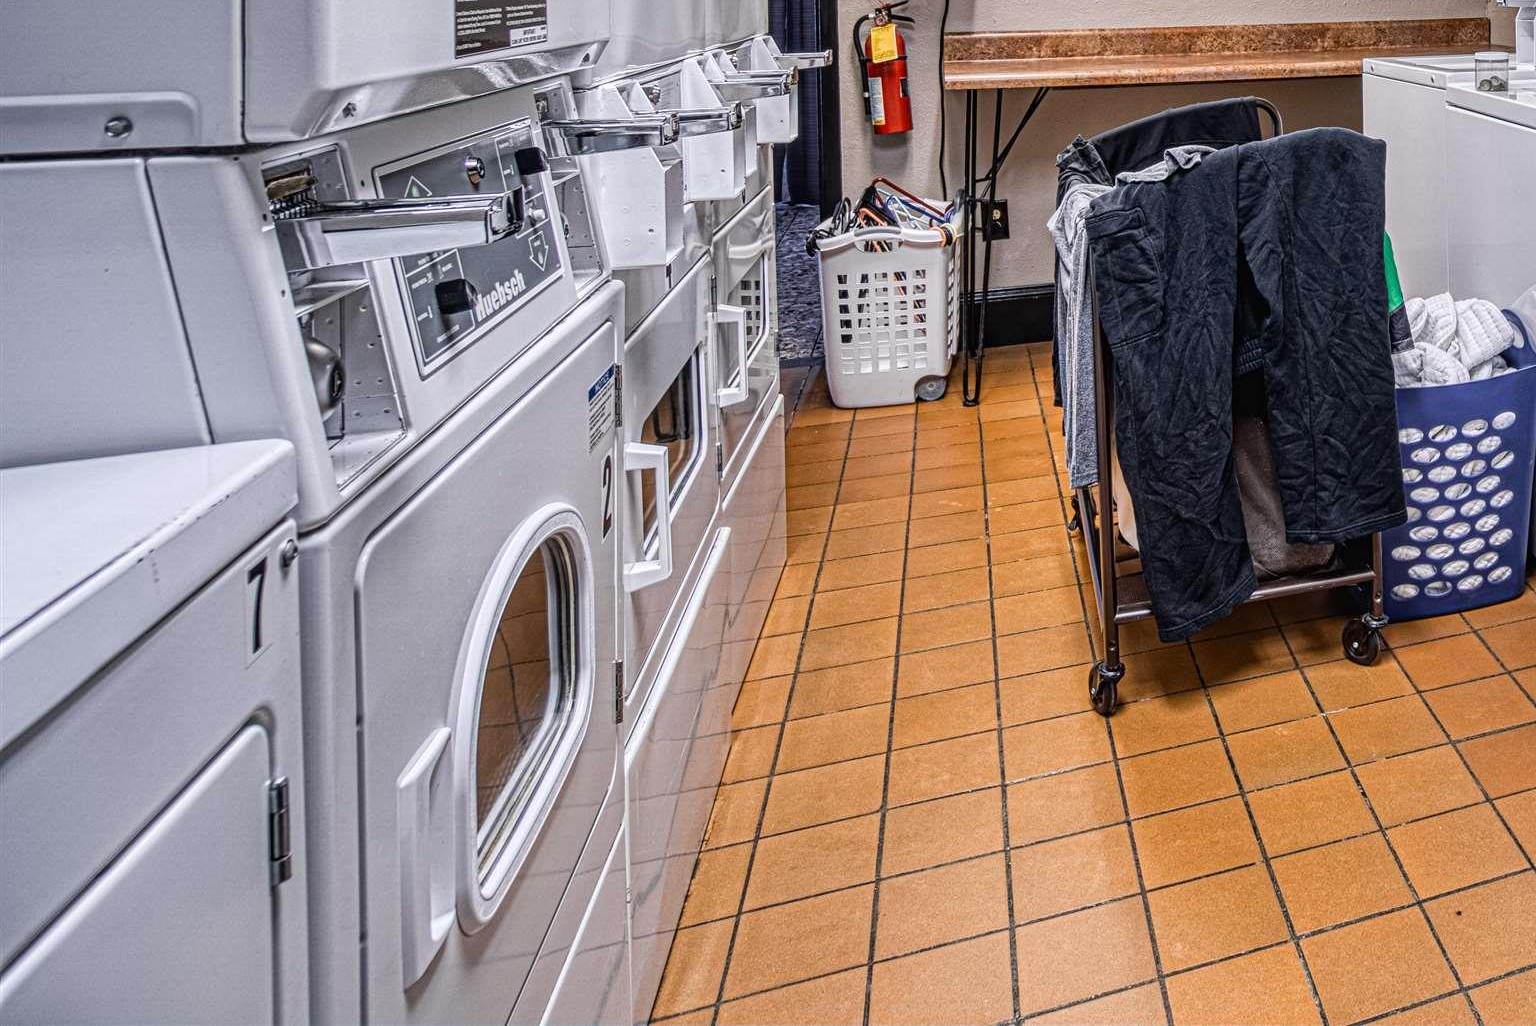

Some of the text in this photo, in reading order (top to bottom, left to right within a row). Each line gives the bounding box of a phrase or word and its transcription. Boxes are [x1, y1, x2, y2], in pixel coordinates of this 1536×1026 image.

[475, 269, 526, 322] Huebsch
[603, 455, 612, 539] 2
[246, 557, 269, 653] 7
